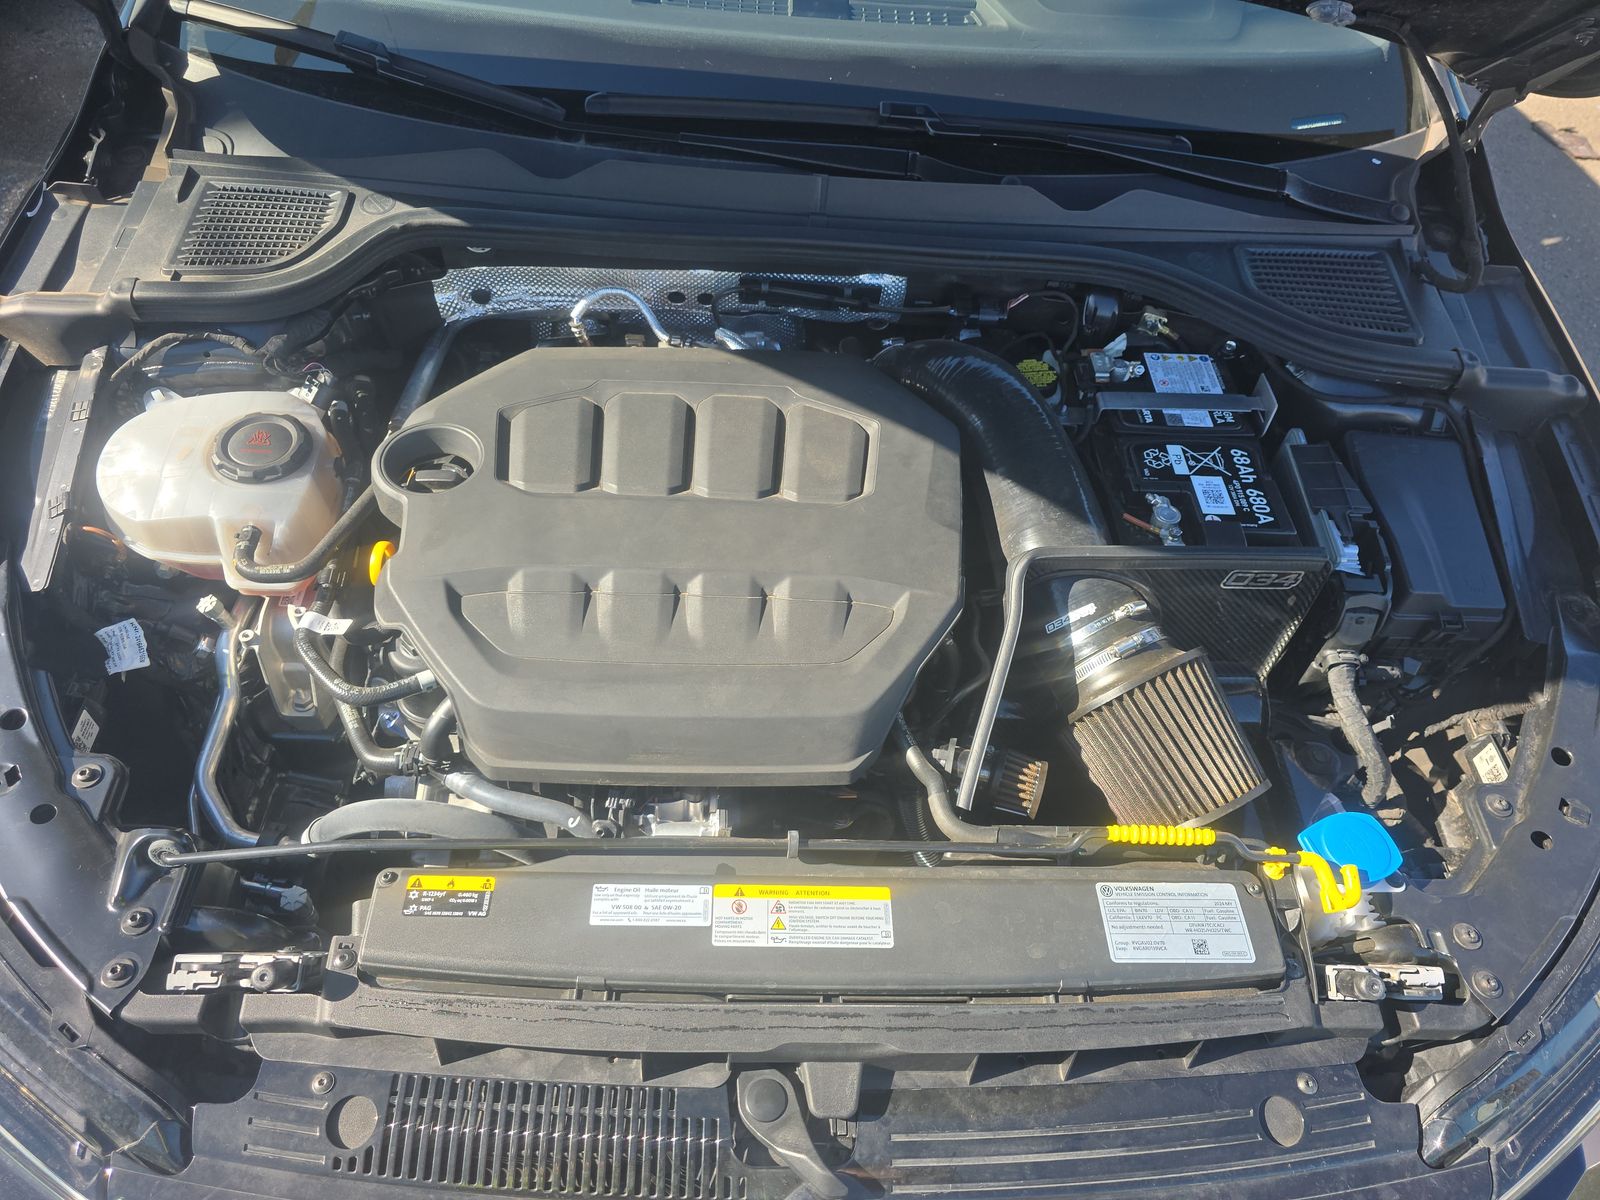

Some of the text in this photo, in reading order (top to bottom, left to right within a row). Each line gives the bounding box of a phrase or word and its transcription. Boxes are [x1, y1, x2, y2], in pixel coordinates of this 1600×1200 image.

[1172, 454, 1182, 465] Pb
[1230, 449, 1257, 483] 68Ah
[1246, 489, 1274, 524] 680A
[1225, 573, 1298, 586] 034
